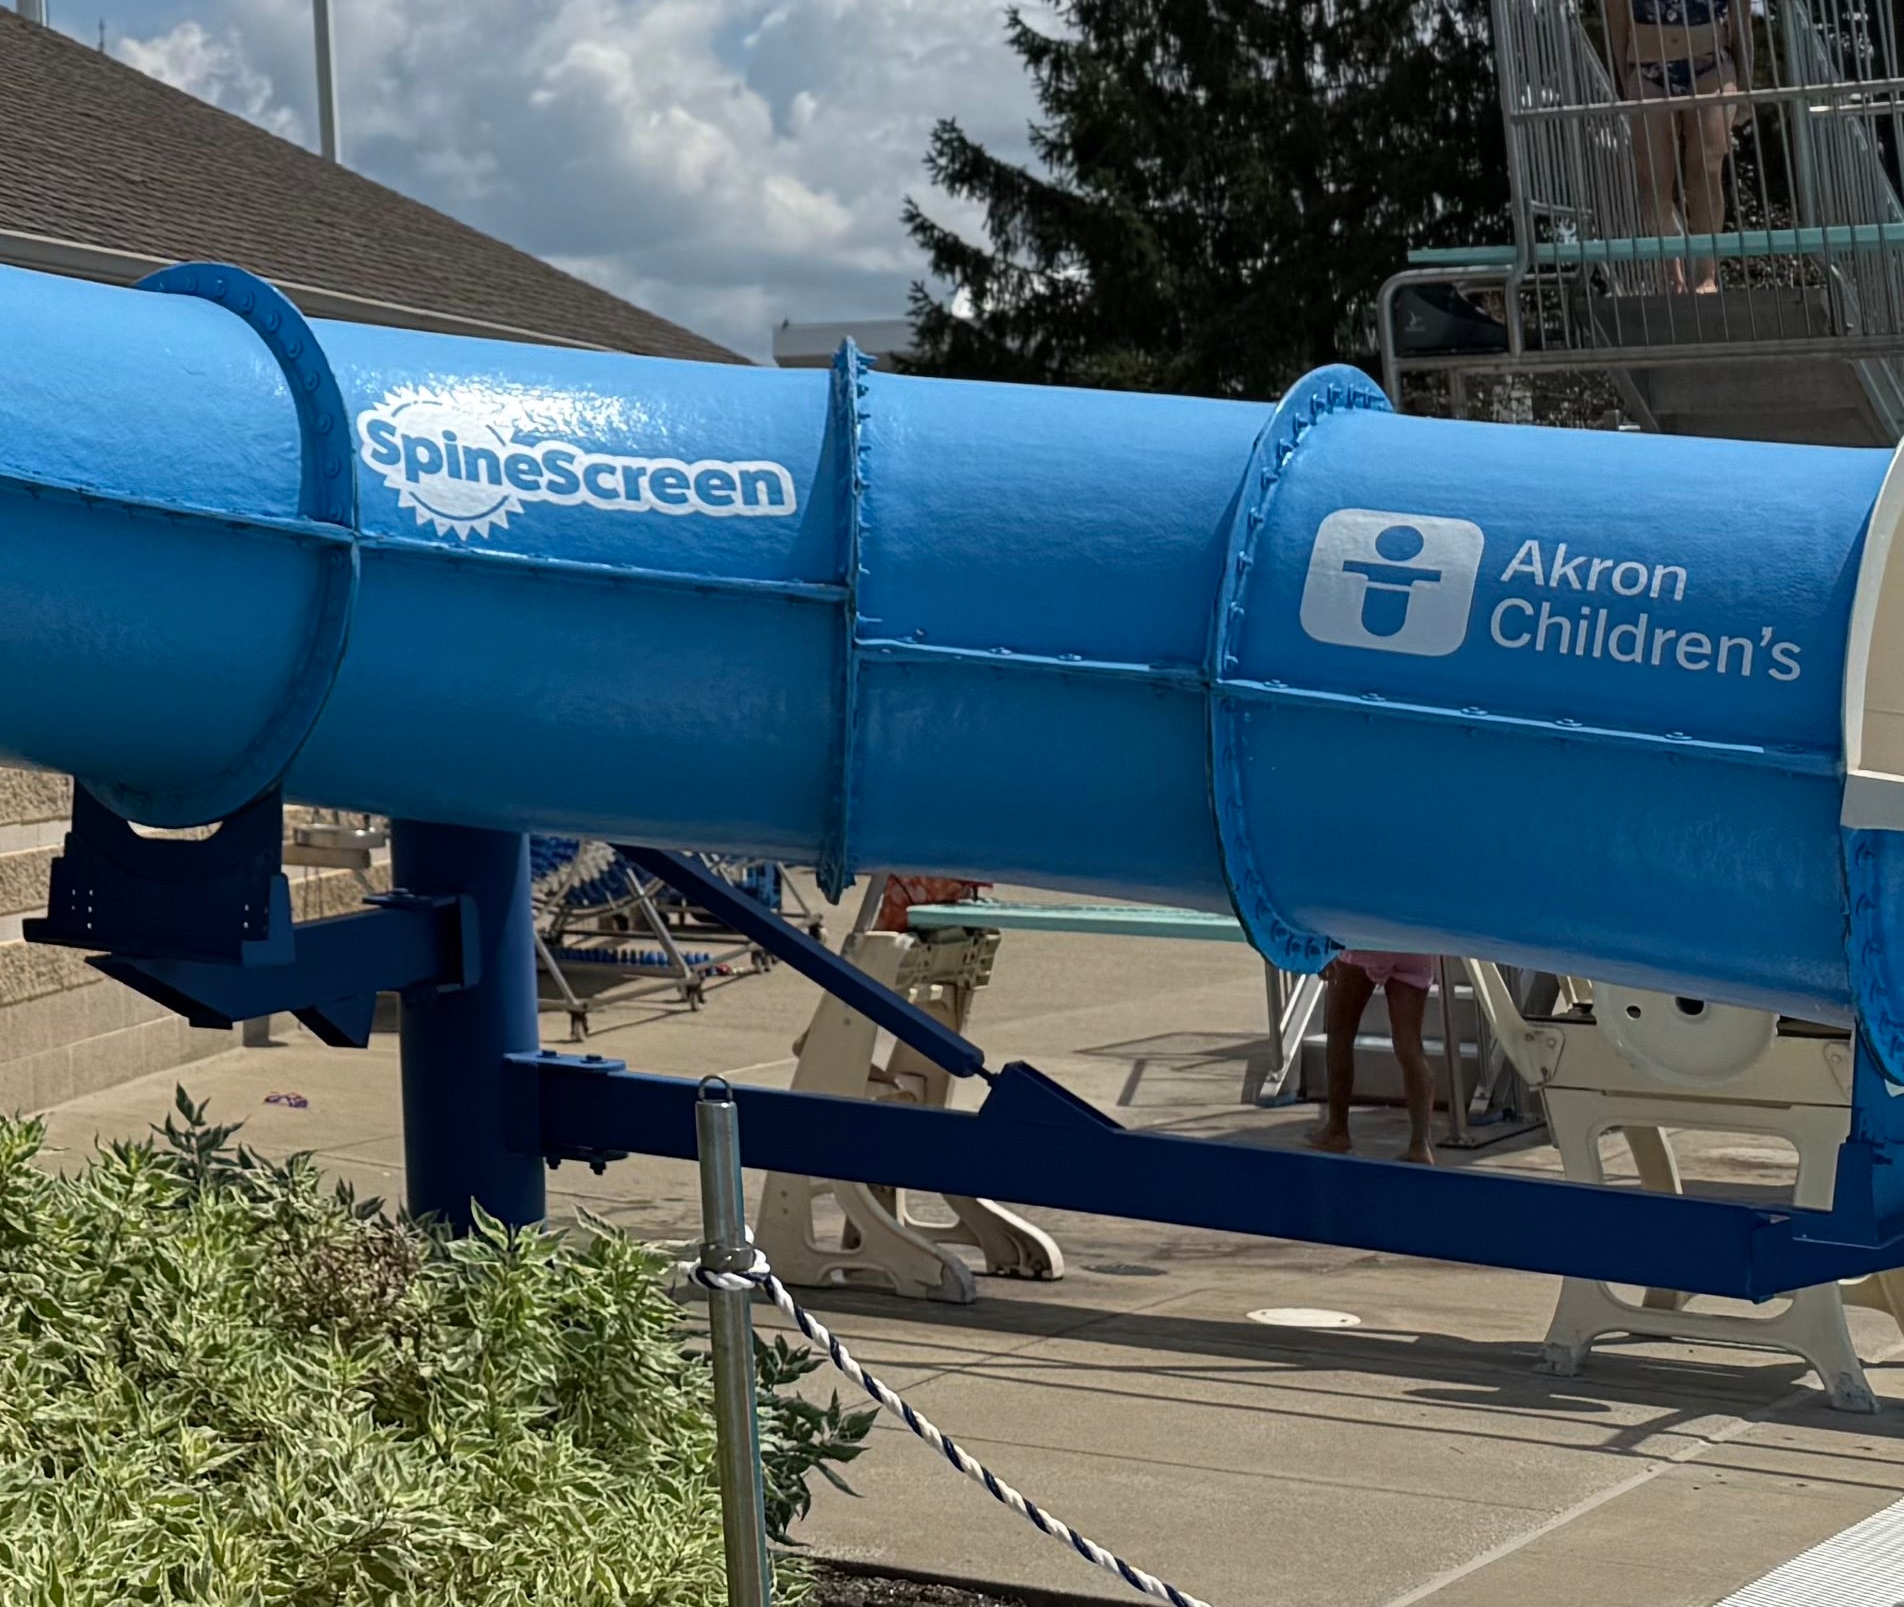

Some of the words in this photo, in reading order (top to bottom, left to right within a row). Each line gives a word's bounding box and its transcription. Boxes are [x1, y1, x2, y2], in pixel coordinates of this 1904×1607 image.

[365, 417, 787, 508] SpineScreen
[1500, 539, 1688, 601] Akron
[1490, 597, 1801, 682] Children's
